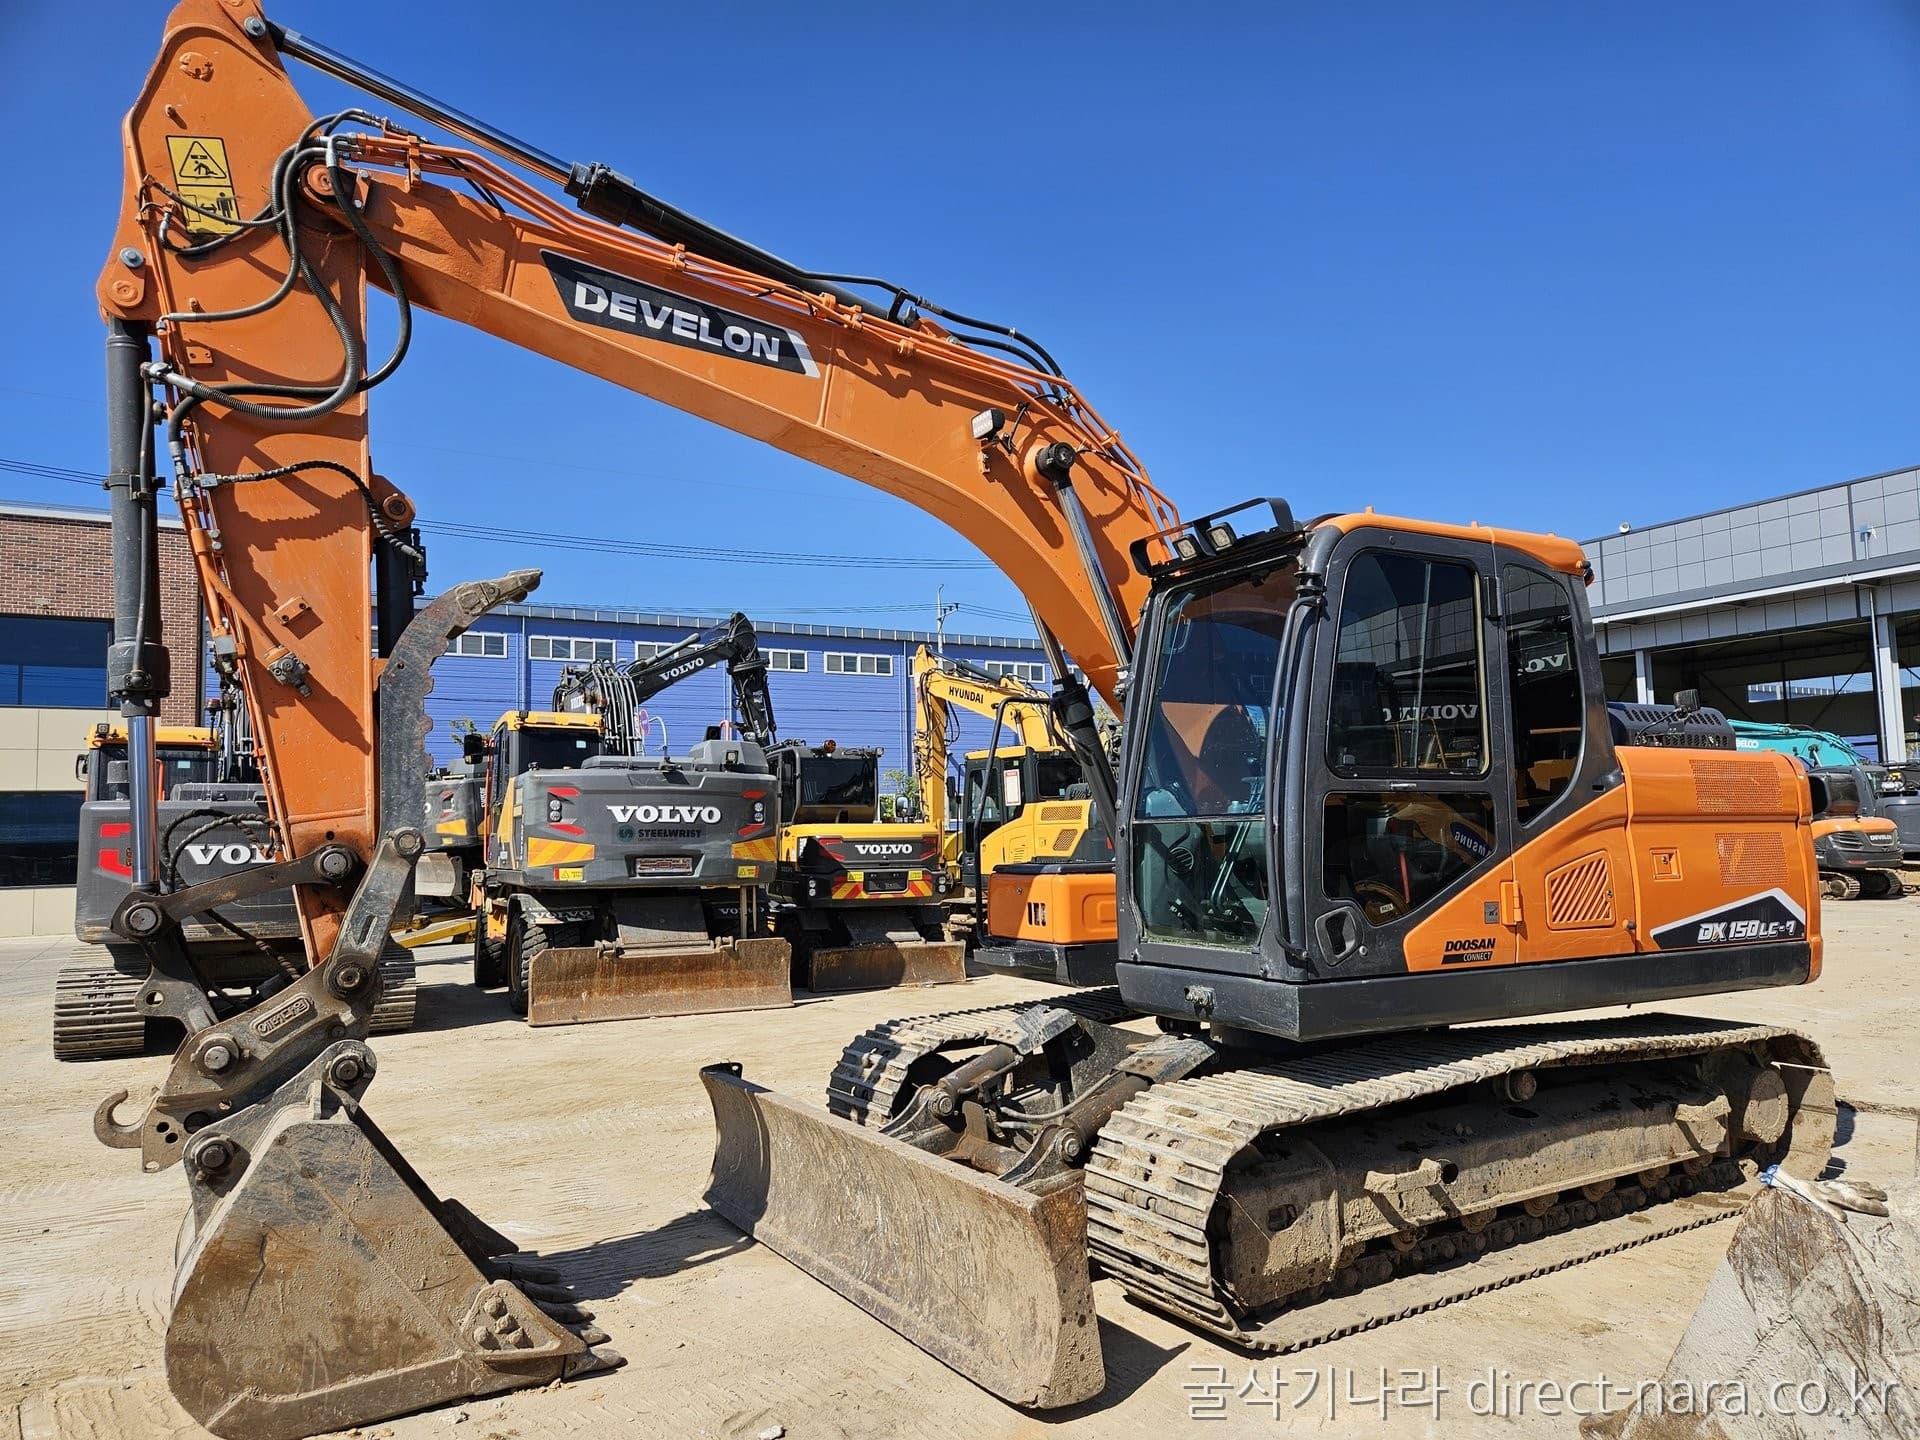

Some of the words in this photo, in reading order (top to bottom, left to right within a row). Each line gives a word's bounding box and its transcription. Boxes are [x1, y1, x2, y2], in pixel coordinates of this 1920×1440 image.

[574, 281, 780, 362] DEVELON
[659, 657, 705, 681] VOLVO
[949, 686, 984, 704] HYUNDAI
[608, 805, 722, 824] VOLVO
[637, 828, 703, 839] STEELWRIST
[855, 844, 913, 855] VOLVO
[1444, 938, 1496, 952] DOOSAN
[1463, 951, 1491, 962] CONNECT
